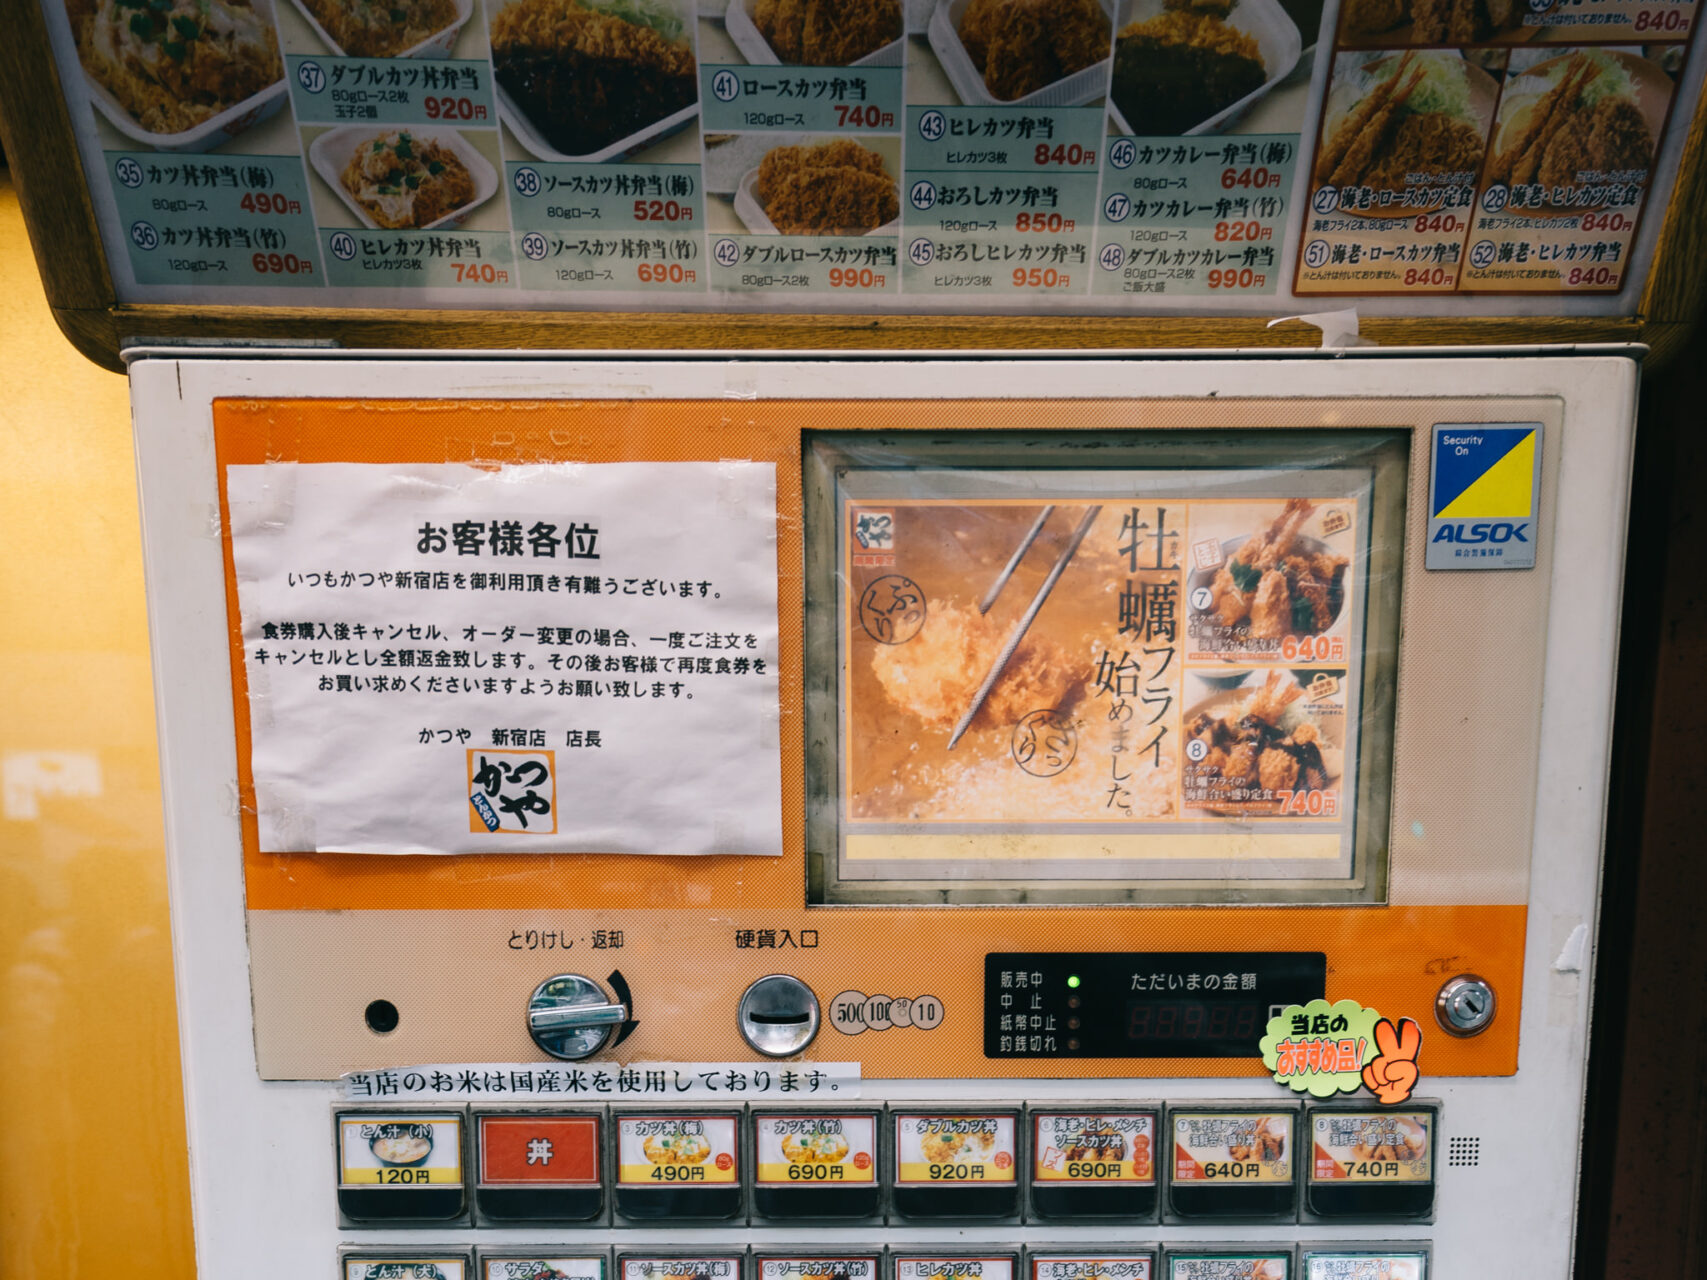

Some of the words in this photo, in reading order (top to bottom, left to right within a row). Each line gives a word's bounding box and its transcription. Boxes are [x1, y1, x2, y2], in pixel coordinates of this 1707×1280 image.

[1634, 11, 1689, 32] 840円
[330, 64, 480, 90] ダブルカツ丼弁当
[743, 78, 867, 101] ロースカツ弁当
[424, 96, 486, 120] 920円
[834, 105, 893, 127] 740円
[744, 112, 805, 126] 120gロース
[950, 117, 1053, 138] ヒレカツ弁当
[947, 151, 1007, 164] ヒレカツ3枚
[1034, 144, 1095, 165] 840円
[1139, 143, 1292, 166] カツカレー弁当（梅）
[147, 165, 273, 188] カツ丼弁当（梅）
[544, 172, 695, 197] ソースカツ丼弁当（梅）
[1221, 168, 1280, 189] 640円
[240, 194, 300, 215] 490円
[937, 187, 1057, 207] おろしカツ弁当
[1341, 187, 1474, 208] 海老・ロースカツ定食
[1511, 185, 1640, 207] 海老・ヒレカツ定食
[547, 207, 601, 219] 80gロース
[634, 201, 692, 221] 520円
[1133, 197, 1284, 220] カツカレー弁当（竹）
[1015, 213, 1075, 233] 850円
[1214, 222, 1272, 242] 820円
[1414, 215, 1464, 233] 840円
[1582, 213, 1632, 231] 840円
[162, 227, 287, 250] カツ丼弁当（竹）
[361, 238, 481, 258] ヒレカツ丼弁当
[552, 239, 697, 260] ソースカツ丼弁当（竹）
[743, 245, 897, 265] ダブルロースカツ弁当
[935, 244, 1086, 264] おろしヒレカツ弁当
[1127, 249, 1274, 268] ダブルカツカレー弁当
[1332, 242, 1460, 264] 海老・ロースカツ弁当
[1497, 241, 1621, 262] 海老・ヒレカツ弁当
[252, 254, 312, 274] 690円
[452, 264, 507, 283] 740円
[637, 264, 696, 283] 690円
[829, 268, 885, 288] 990円
[1012, 268, 1070, 288] 950円
[1208, 269, 1264, 289] 990円
[1404, 269, 1453, 285] 840円
[1568, 268, 1618, 285] 840円
[1443, 435, 1483, 445] Security
[1455, 446, 1468, 456] On
[417, 521, 601, 560] お客様各位
[1432, 523, 1529, 543] ALSOK
[287, 570, 722, 599] いつもかつや新宿店を御利用頂き有難うございます。
[262, 622, 759, 650] 食券購入後キャンセル、オーダー変更の場合、一度ご注文を
[1117, 506, 1180, 768] 牡蠣フライ
[1282, 636, 1344, 661] 640円
[255, 649, 766, 675] キャンセルとし全額返金致します。その後お客様で再度食券を
[318, 675, 696, 700] お買い求めくださいますようお願い致します。
[419, 728, 471, 744] かつや
[492, 729, 546, 747] 新宿店
[567, 730, 602, 748] 店長
[1095, 652, 1139, 817] 始めました。
[1277, 790, 1336, 815] 740円
[508, 930, 624, 950] とりけし・返却
[736, 929, 819, 949] 硬貨入口
[1000, 972, 1043, 988] 販売中
[1131, 972, 1257, 991] ただいまの金額
[897, 1000, 907, 1008] 50
[918, 1003, 934, 1021] 10
[1000, 1014, 1057, 1031] 紙幣中止
[1291, 1014, 1349, 1035] 当店の
[1000, 1035, 1057, 1052] 釣銭切れ
[349, 1068, 841, 1096] 当店のお米は国産米を使用しております。
[917, 1120, 998, 1134] ダブルカツ丼
[1055, 1134, 1122, 1149] ソースカツ丼
[528, 1138, 553, 1166] 丼
[651, 1166, 704, 1181] 490円
[788, 1164, 843, 1179] 690円
[1068, 1163, 1121, 1178] 690円
[1204, 1163, 1260, 1178] 640円
[1344, 1162, 1398, 1177] 740円
[505, 1262, 544, 1275] サラダ
[916, 1263, 982, 1276] ヒレカツ丼
